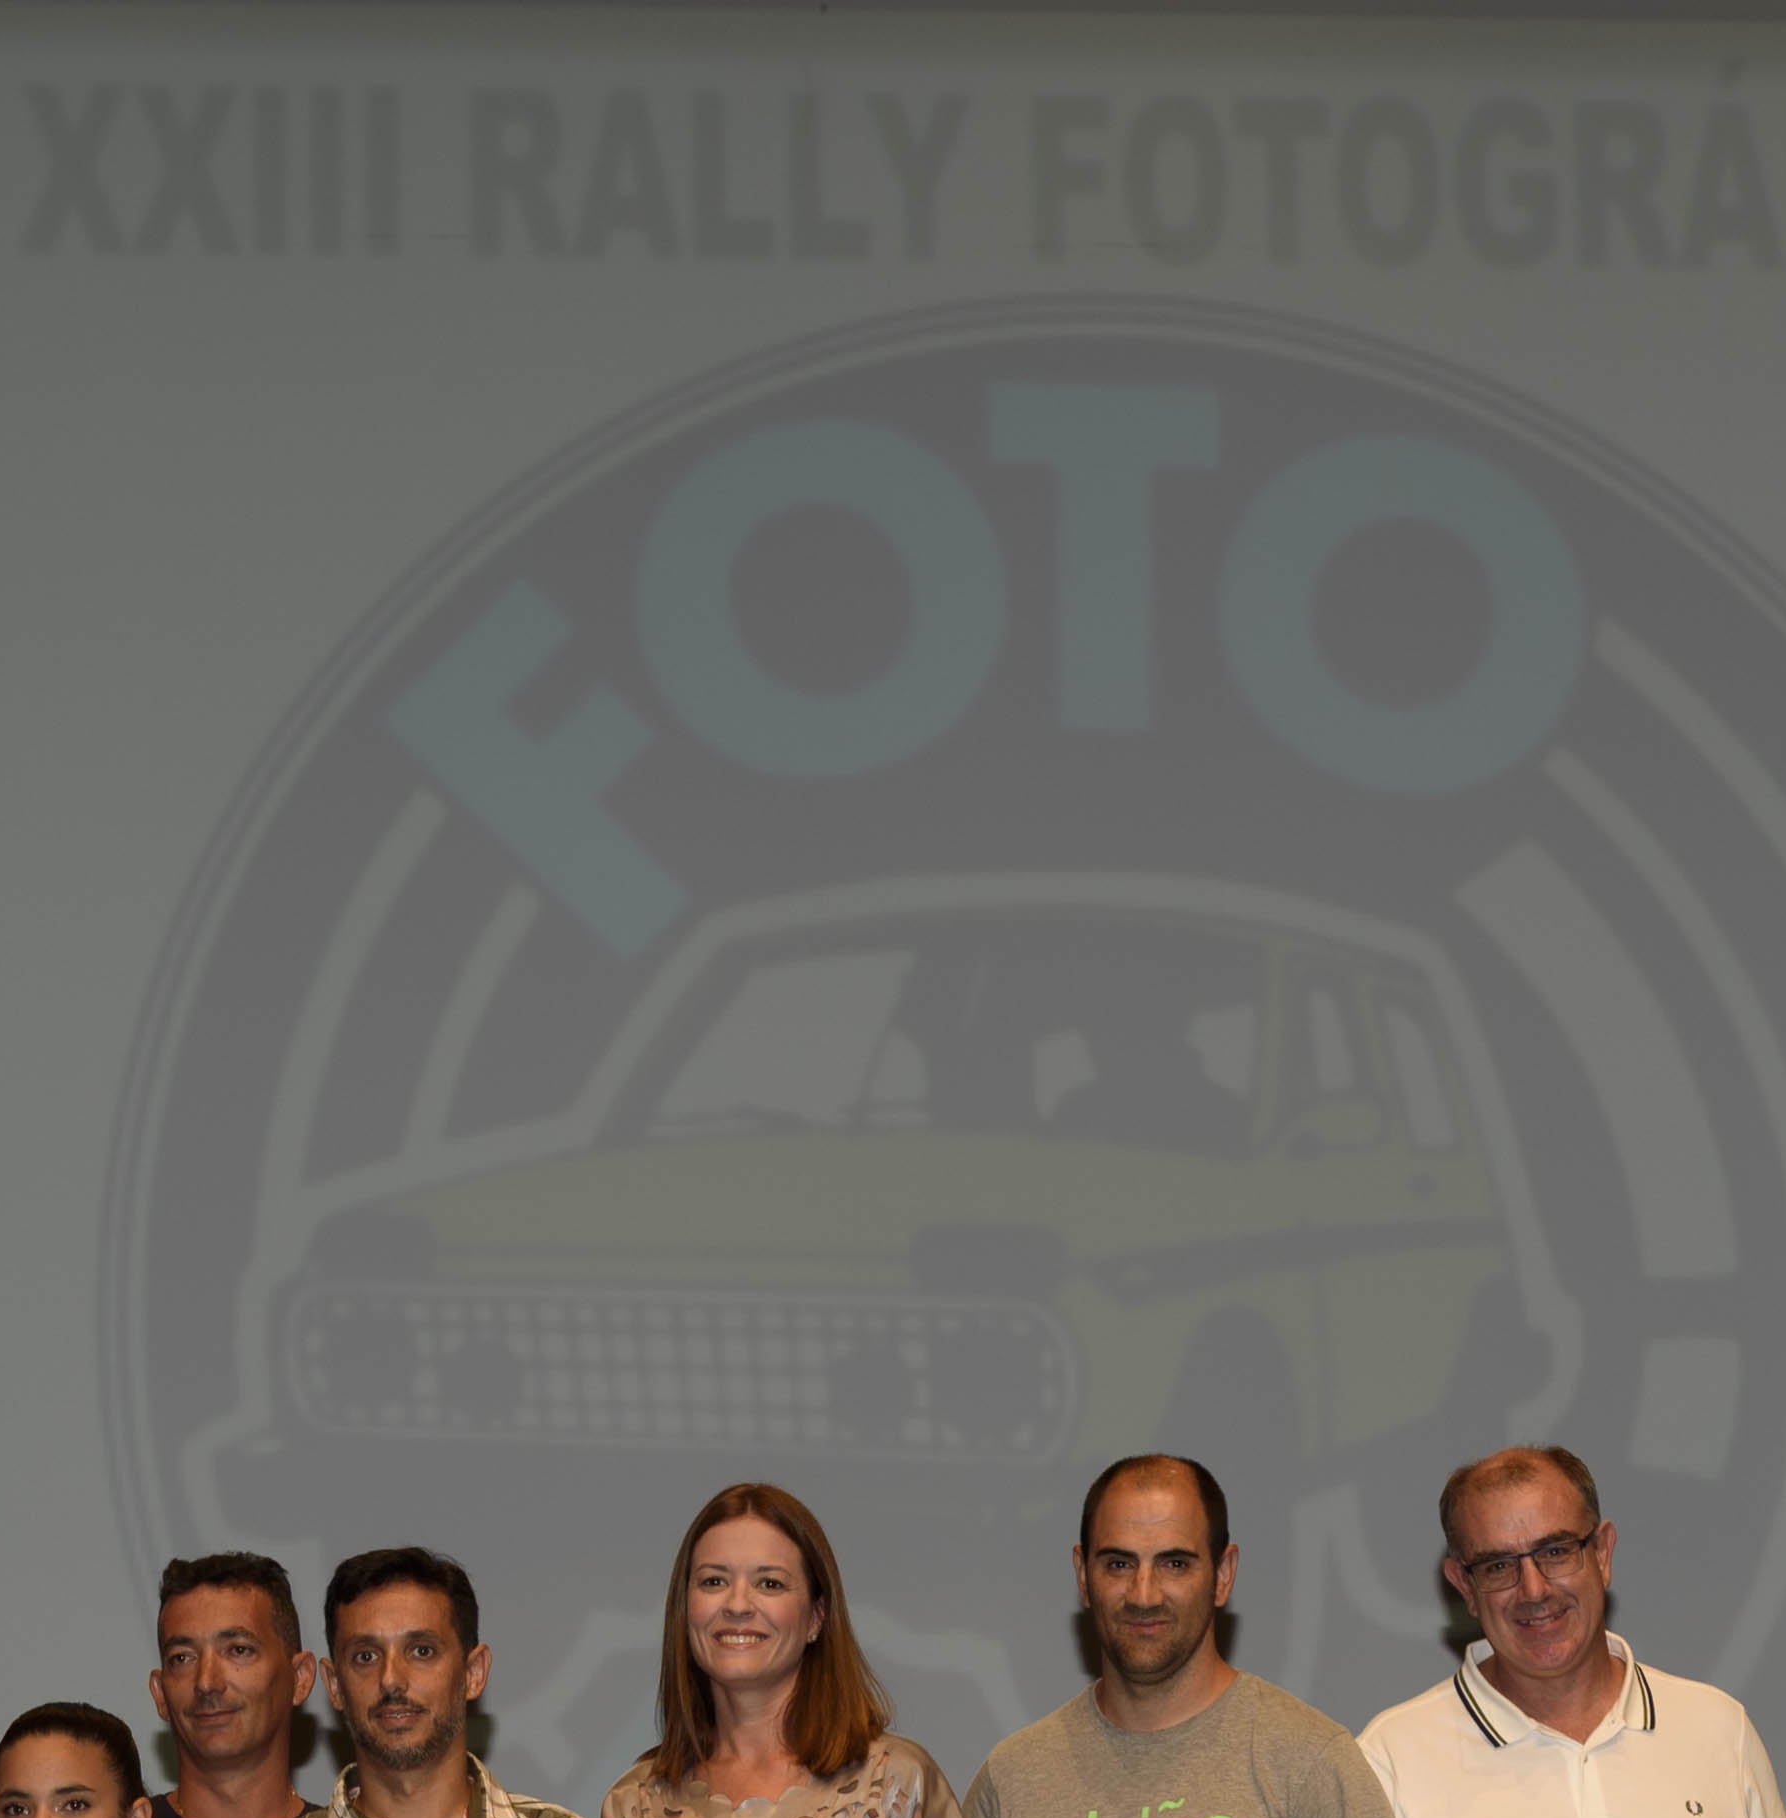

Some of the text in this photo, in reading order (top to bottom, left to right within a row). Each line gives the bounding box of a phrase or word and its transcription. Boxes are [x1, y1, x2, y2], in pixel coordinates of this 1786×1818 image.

[20, 80, 405, 260] XXIII
[469, 88, 968, 264] RALLY
[385, 378, 1591, 962] FOTO
